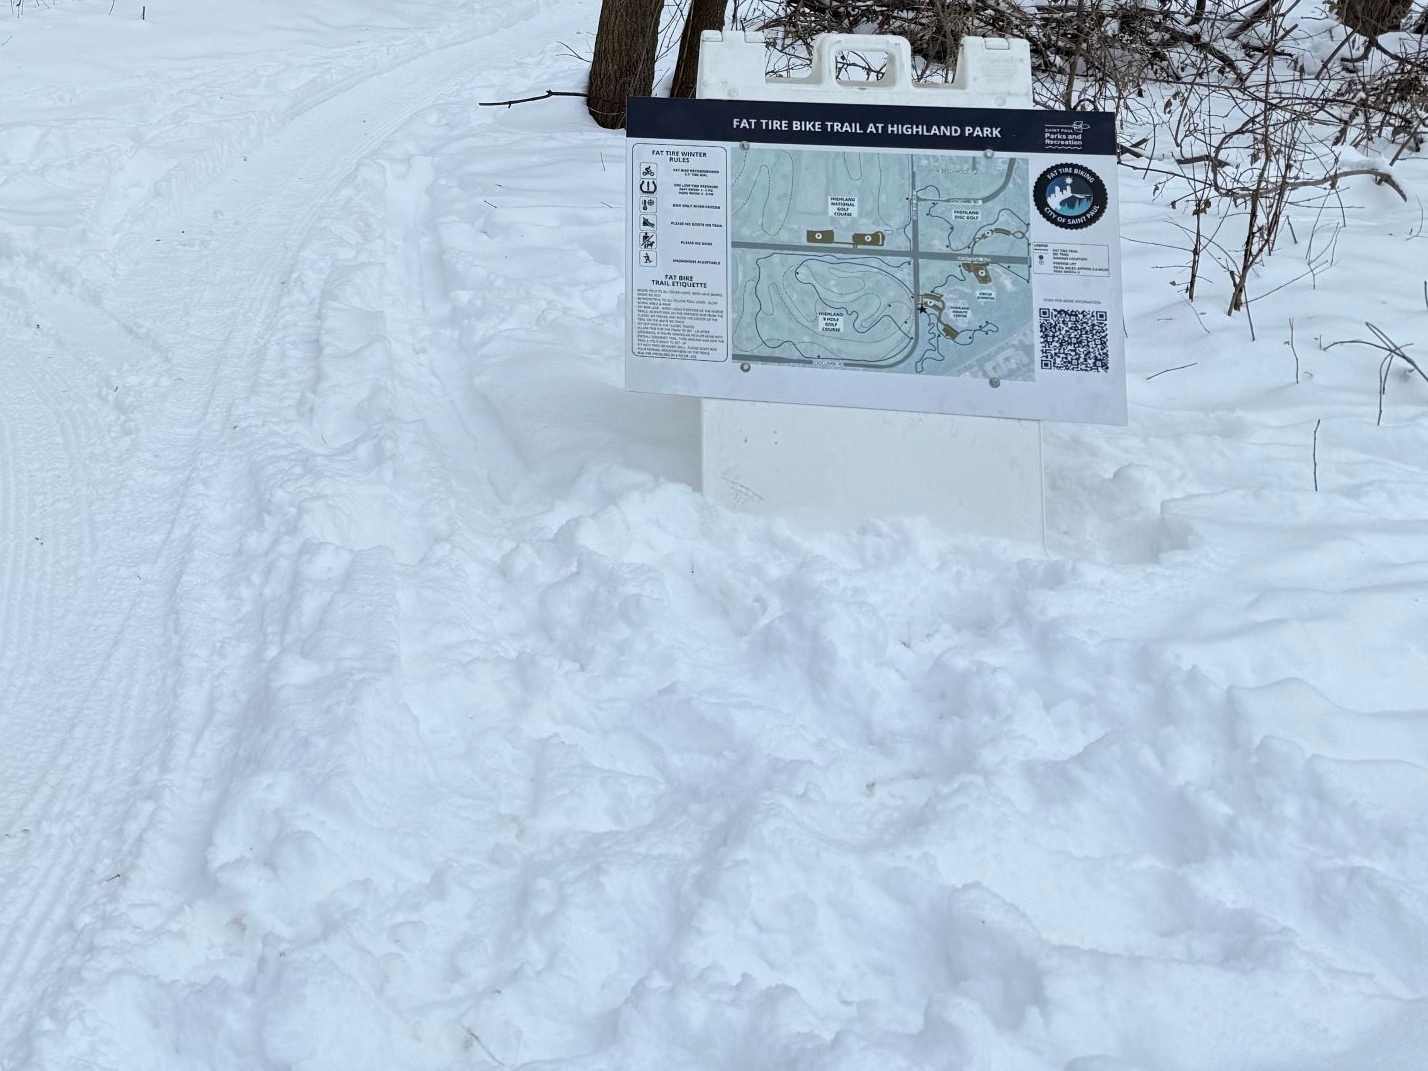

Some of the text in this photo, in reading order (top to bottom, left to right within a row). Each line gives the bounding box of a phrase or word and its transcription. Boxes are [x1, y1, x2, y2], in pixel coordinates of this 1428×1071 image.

[733, 118, 1002, 138] FAT TIRE BIKE TRAIL AT HIGHLAND PARK
[1047, 167, 1096, 184] FAT TIRE BIKING
[1044, 205, 1100, 225] CITY OF SAINT PAUL
